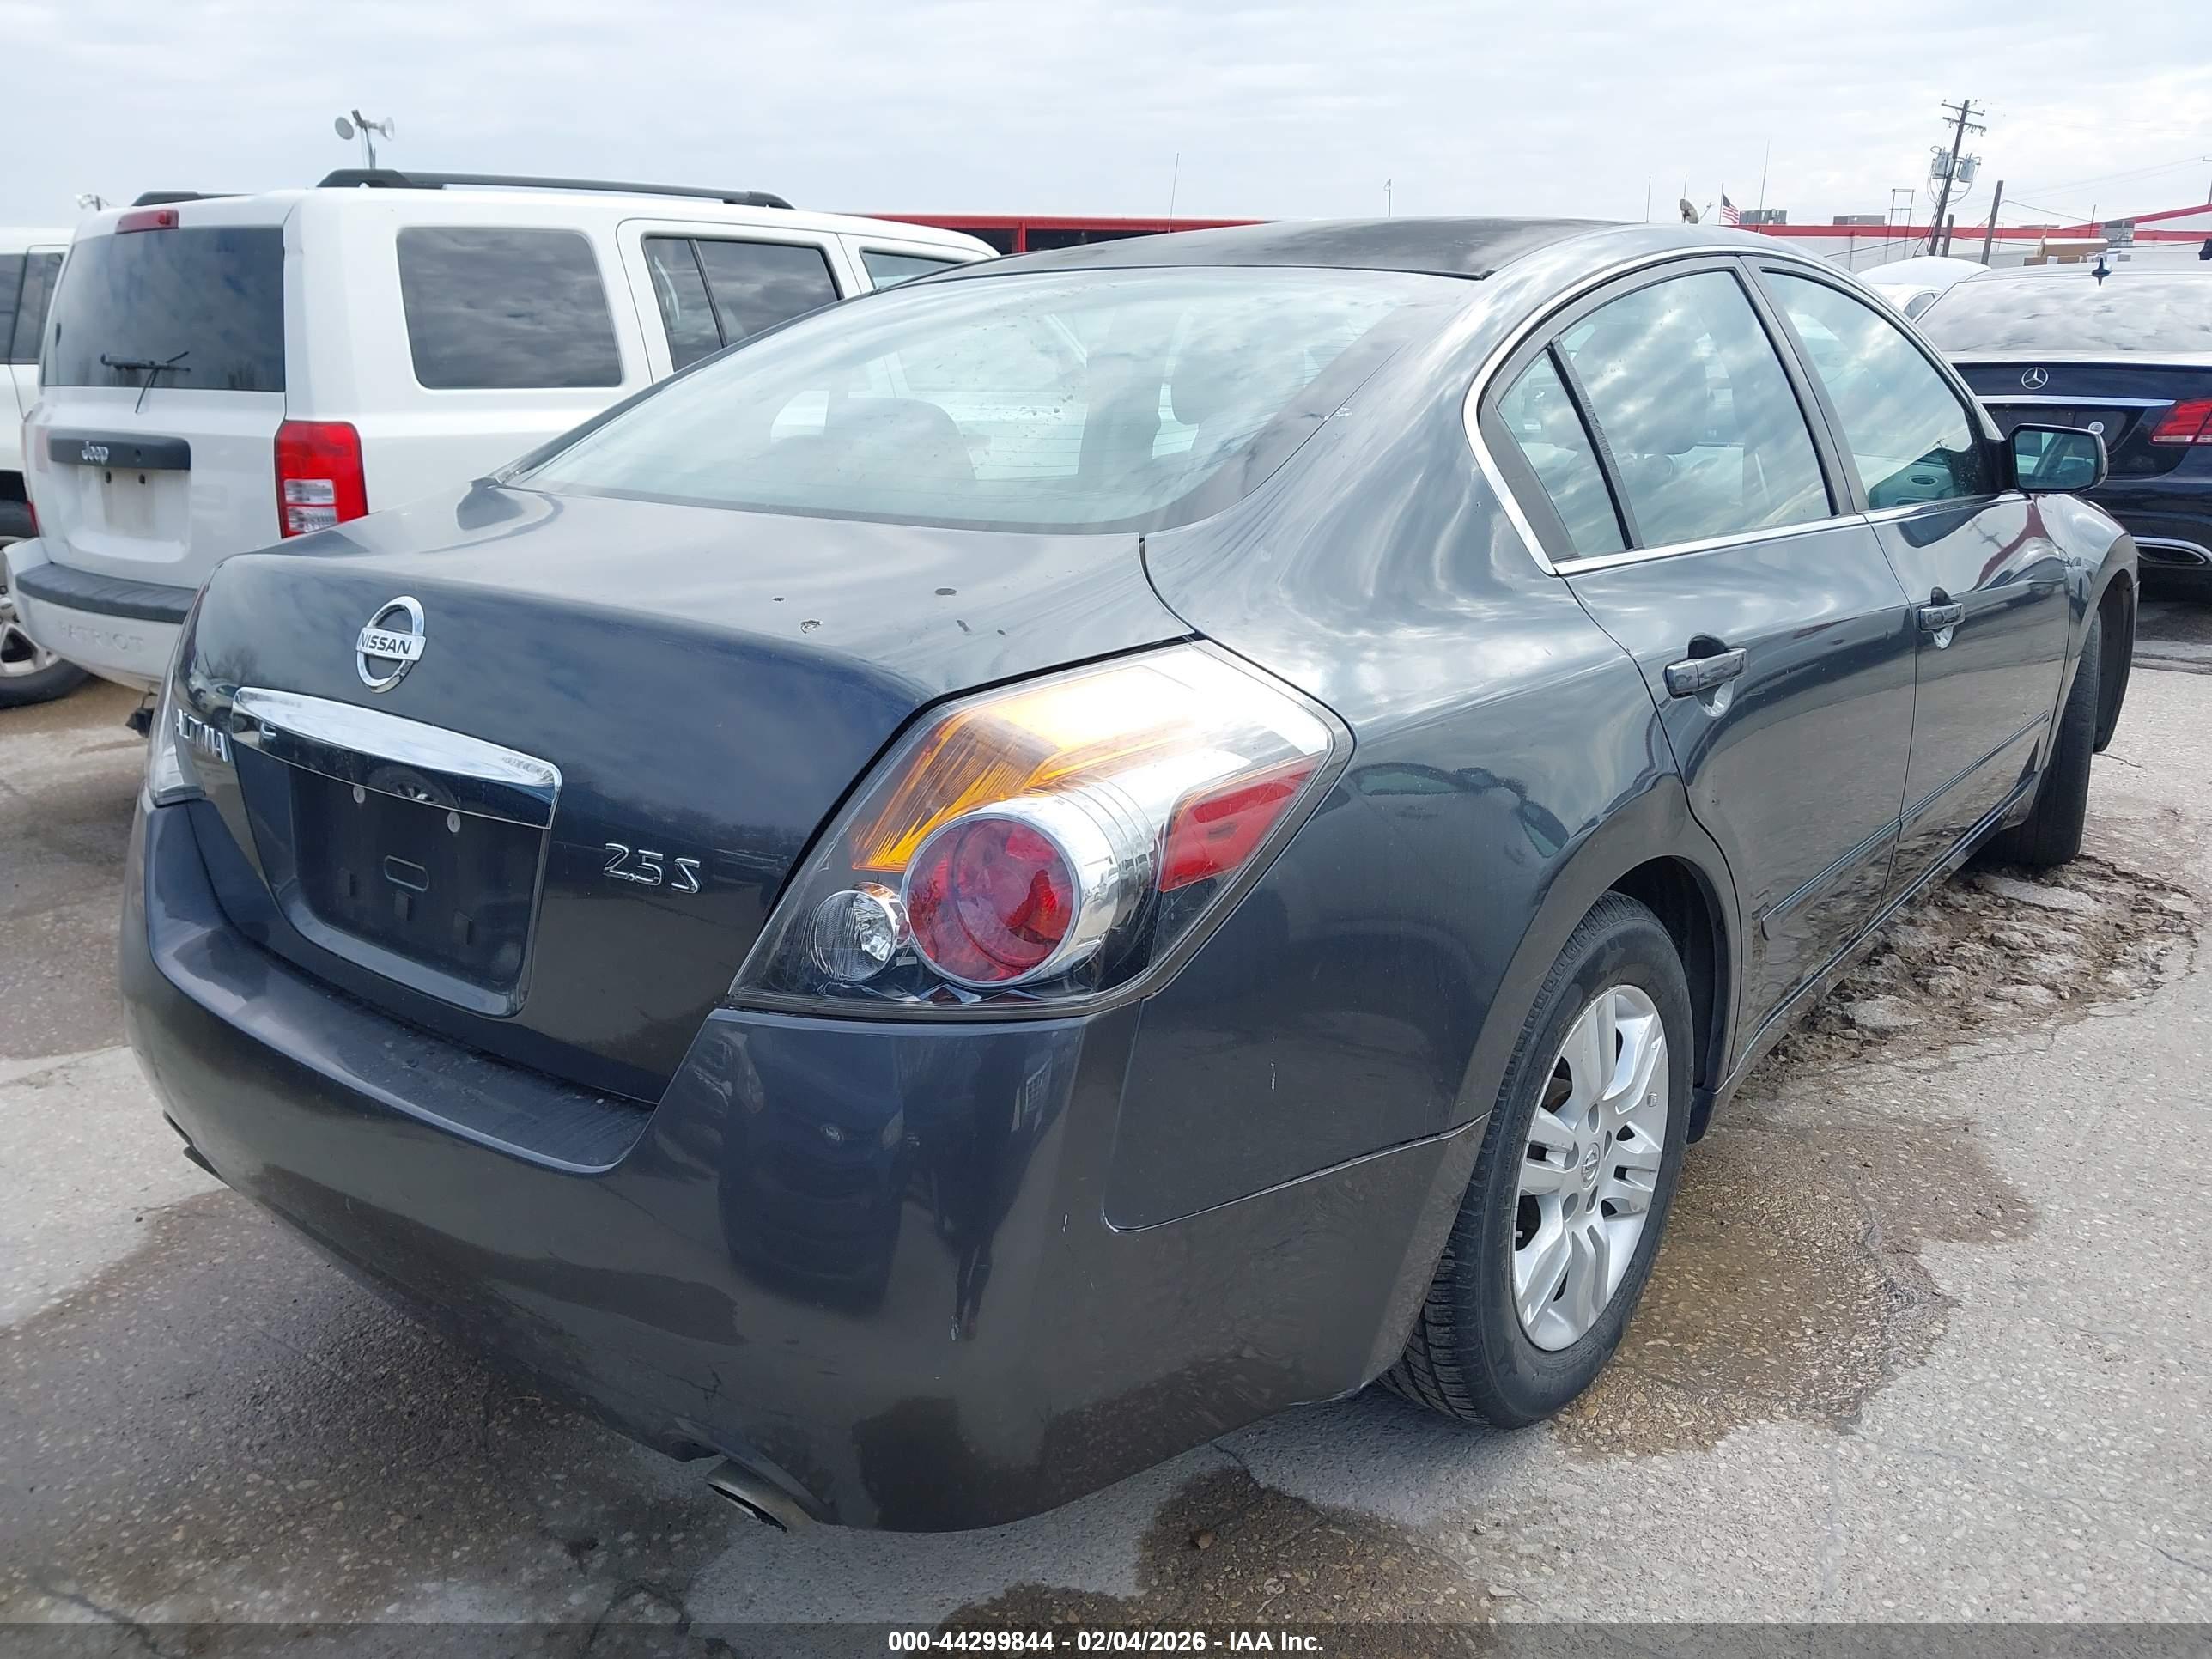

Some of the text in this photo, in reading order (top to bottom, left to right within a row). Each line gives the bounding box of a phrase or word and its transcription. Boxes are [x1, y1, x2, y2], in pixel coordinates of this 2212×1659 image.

[82, 441, 109, 465] Jeep
[359, 631, 412, 654] NISSAN
[603, 842, 701, 894] 2.5 S
